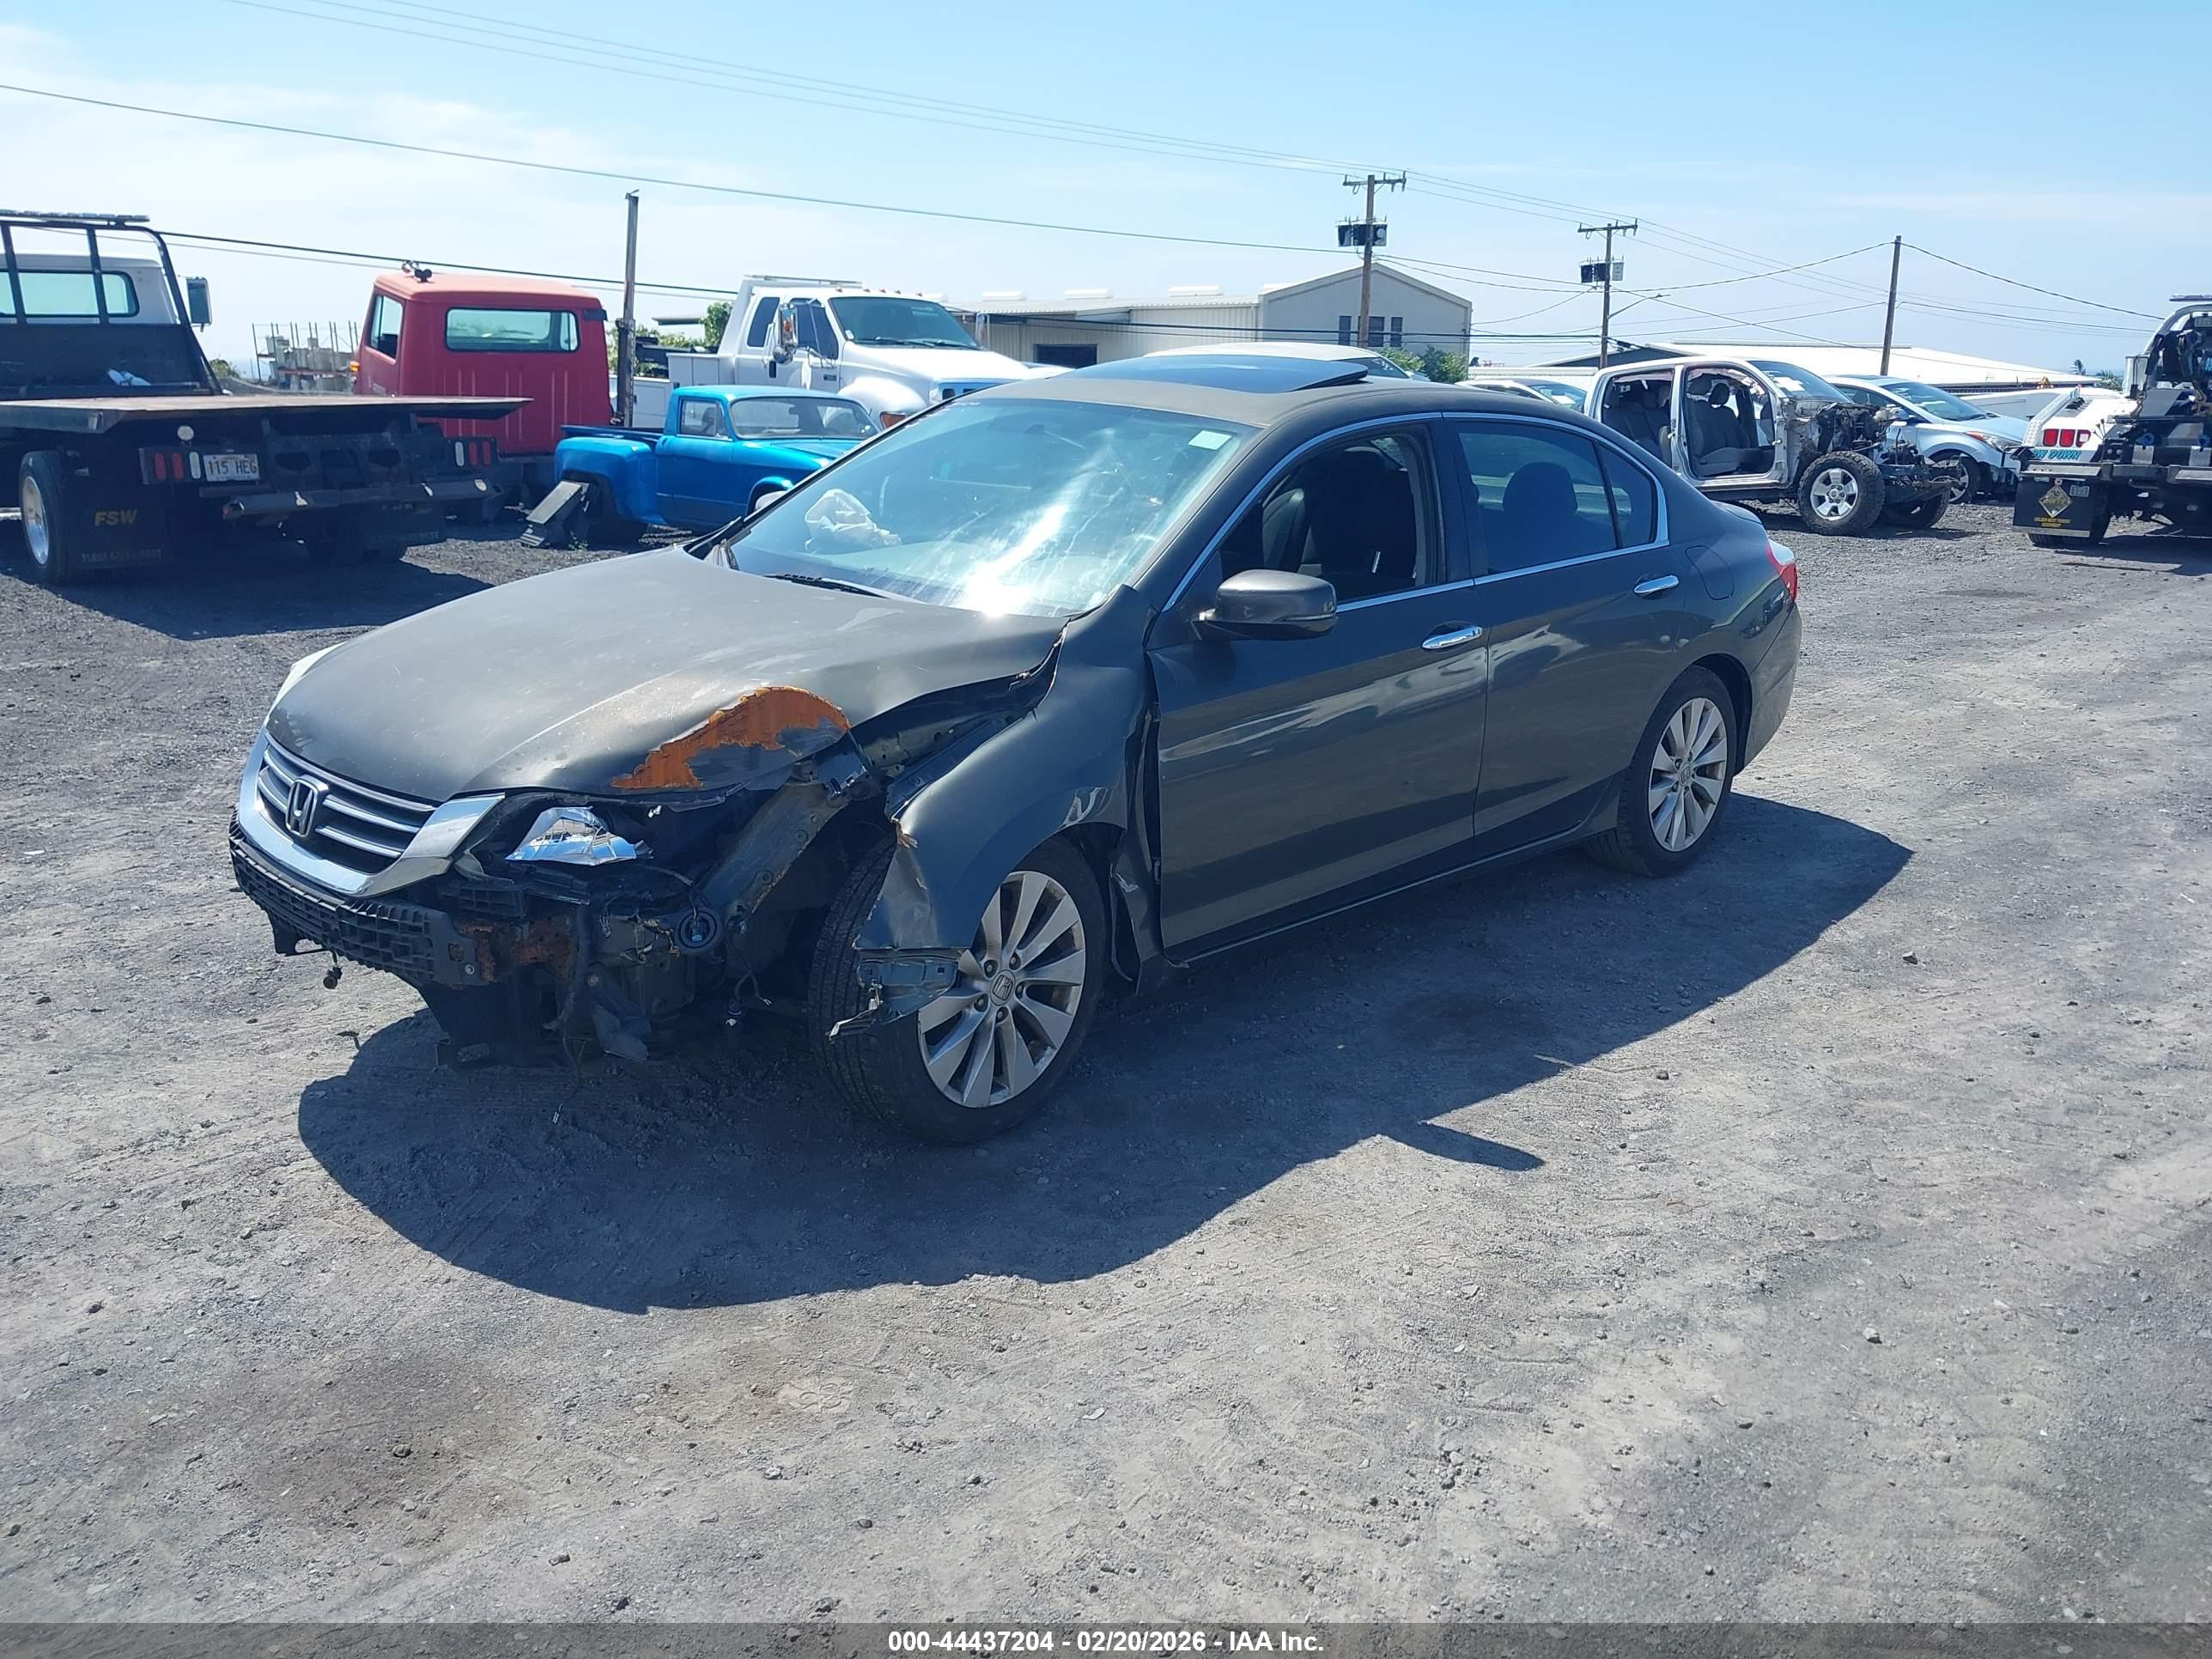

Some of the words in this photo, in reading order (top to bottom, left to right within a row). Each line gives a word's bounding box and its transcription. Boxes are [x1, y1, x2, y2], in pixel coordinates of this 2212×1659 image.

[2048, 448, 2082, 461] DOWN
[208, 460, 229, 475] 115
[234, 459, 258, 474] HEG
[94, 509, 137, 526] FSW
